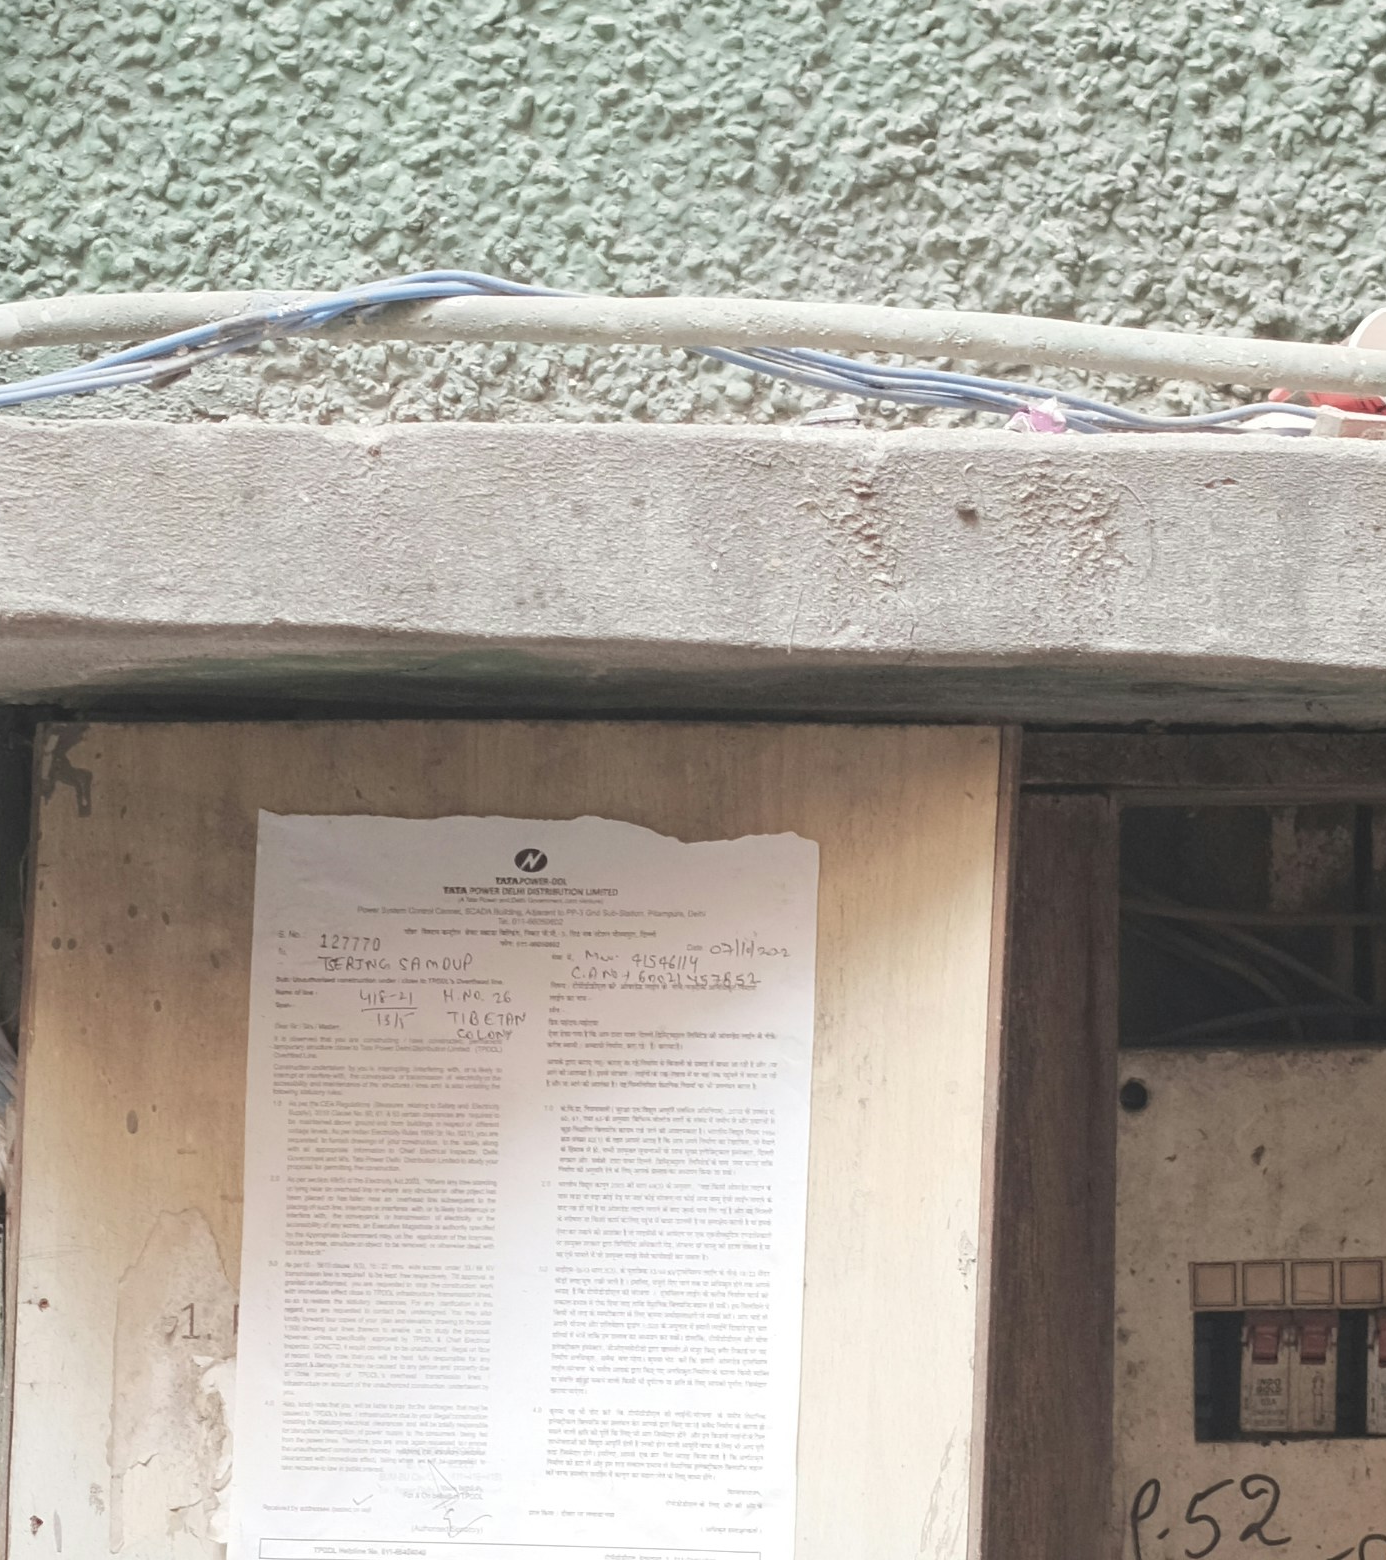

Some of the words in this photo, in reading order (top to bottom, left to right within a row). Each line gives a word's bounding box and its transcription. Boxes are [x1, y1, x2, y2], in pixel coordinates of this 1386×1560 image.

[443, 886, 467, 894] TATA
[469, 887, 500, 895] POWER
[527, 888, 583, 896] DISTRIBUTION
[319, 933, 382, 952] 127770
[446, 1011, 527, 1027] TIBETAN
[456, 1028, 514, 1041] COLONY
